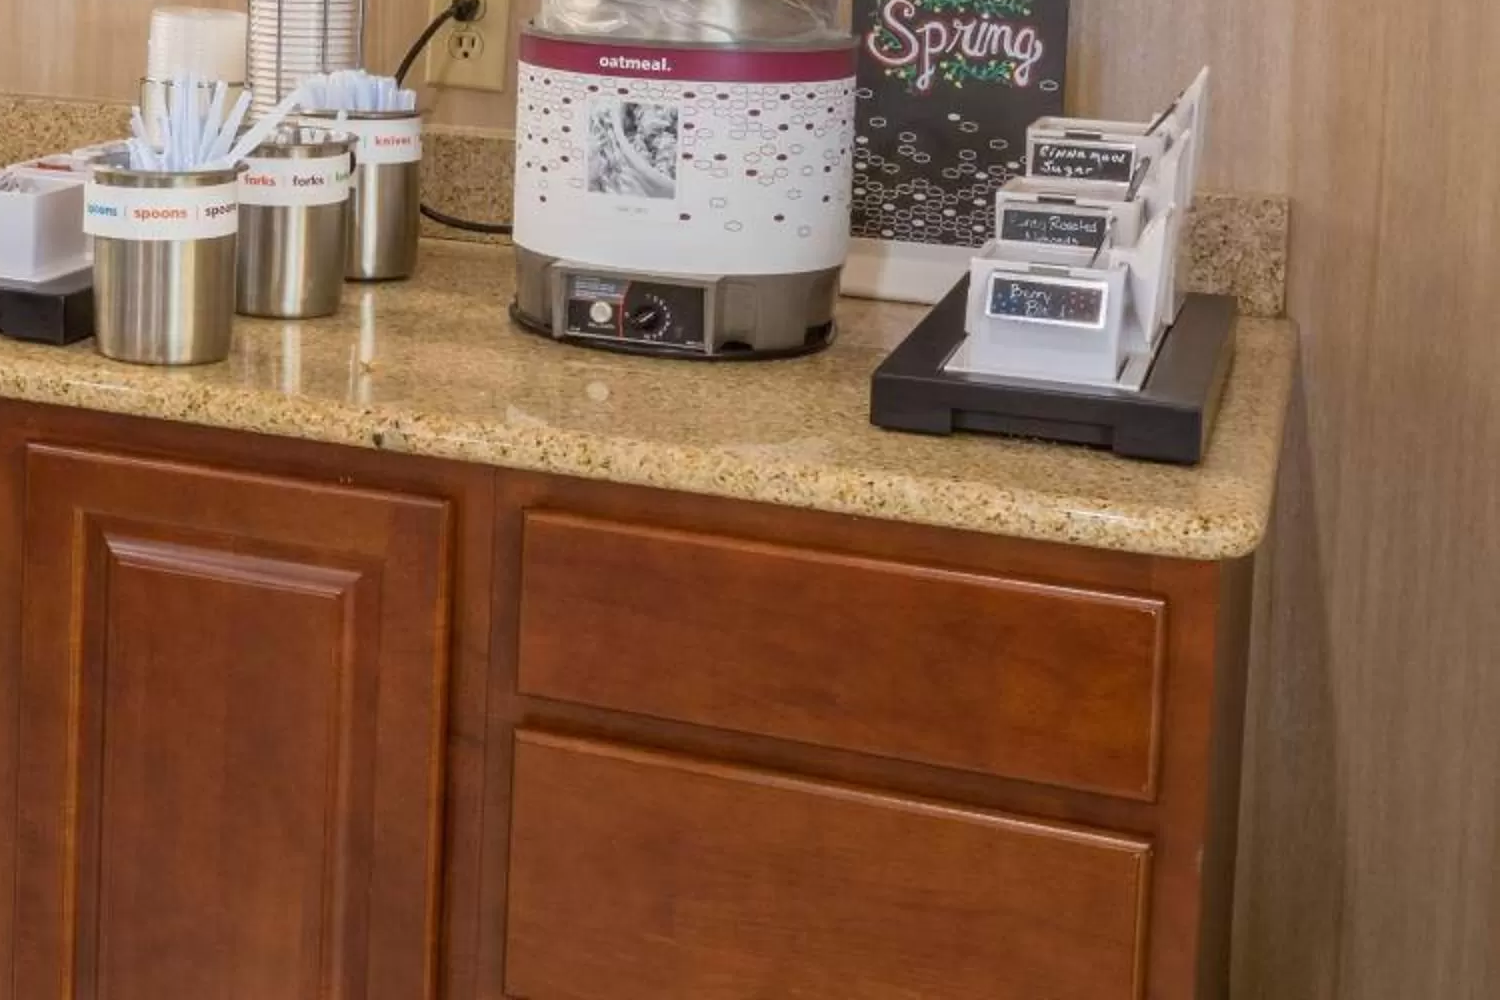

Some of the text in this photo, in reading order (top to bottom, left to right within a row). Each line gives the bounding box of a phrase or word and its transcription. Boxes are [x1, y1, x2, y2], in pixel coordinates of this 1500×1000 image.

[599, 55, 673, 72] oatmeal.
[375, 135, 411, 146] knives
[292, 177, 325, 187] forks
[133, 206, 188, 221] spoons
